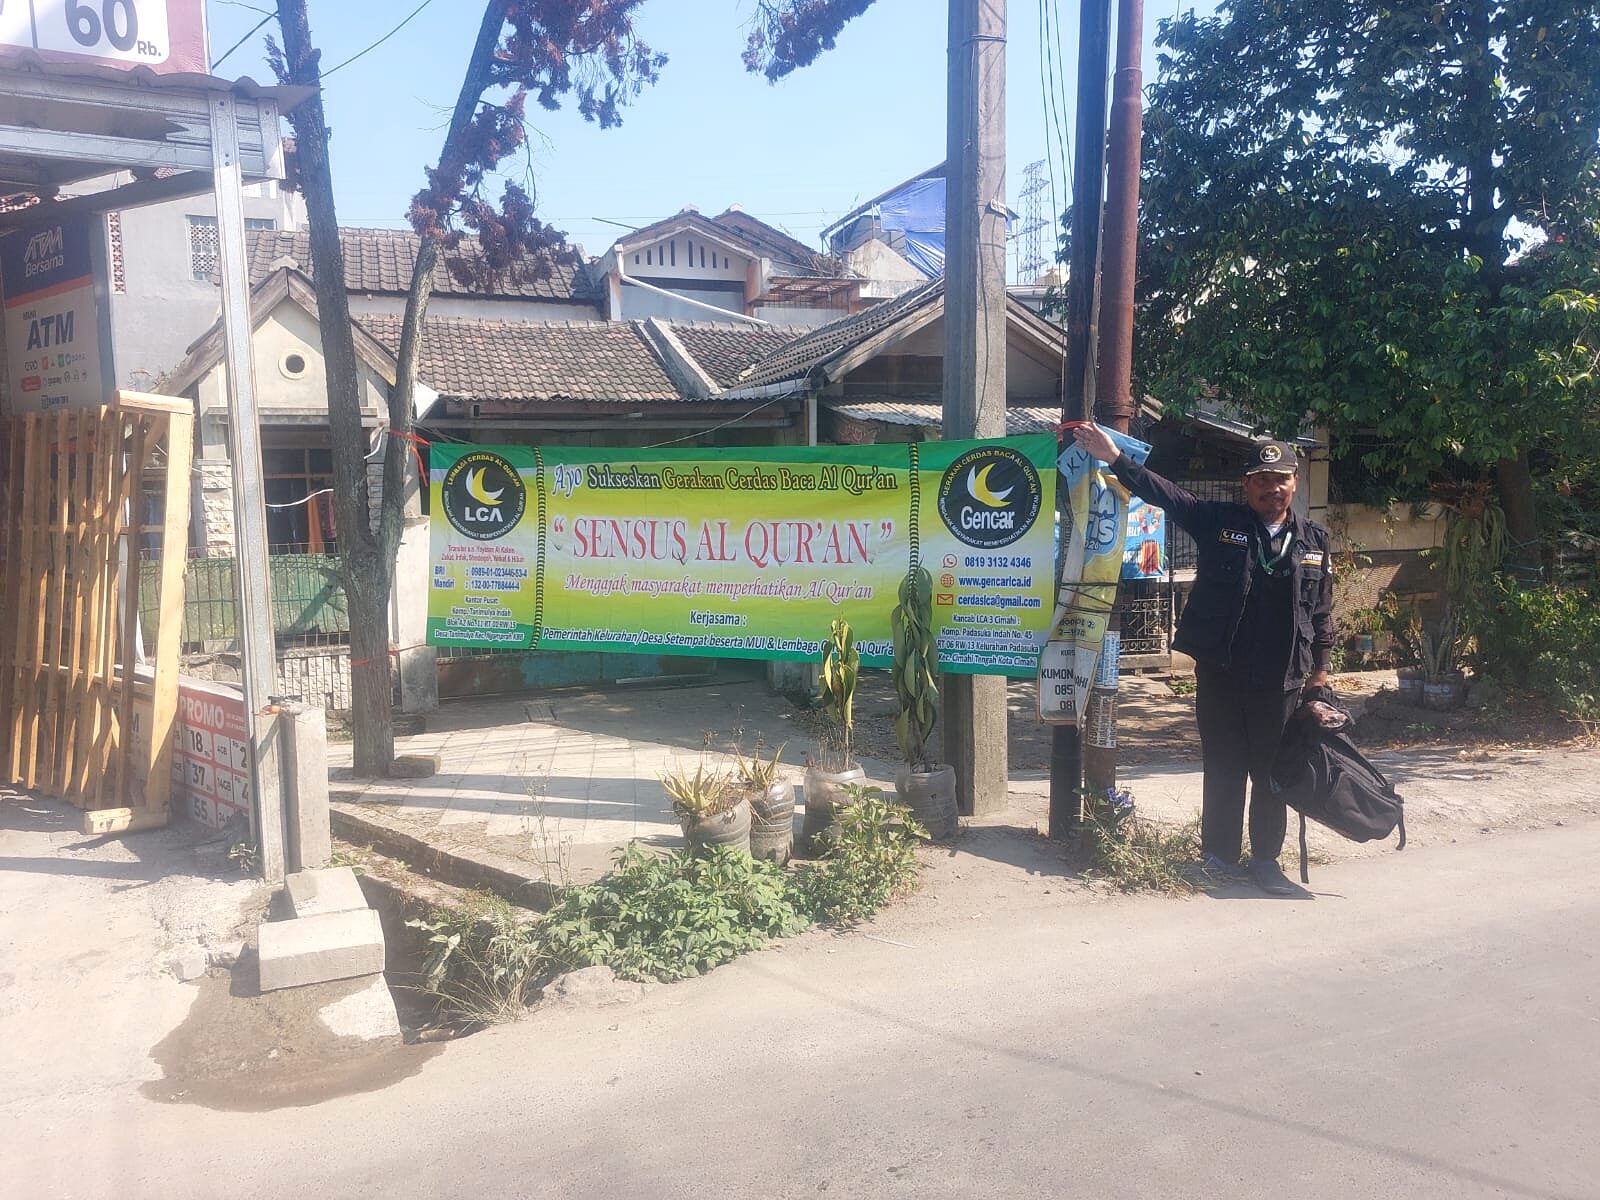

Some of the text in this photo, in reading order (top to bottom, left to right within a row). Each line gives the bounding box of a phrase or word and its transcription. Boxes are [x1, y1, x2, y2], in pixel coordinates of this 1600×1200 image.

[65, 0, 162, 57] 60 Rb.
[24, 226, 63, 262] ATM
[25, 254, 64, 278] Bersama
[27, 310, 74, 351] ATM
[552, 464, 898, 497] Ayo Sukseskan Gerakan Cerdas Baca Al Qur'an
[943, 464, 962, 496] GERAKAN
[962, 450, 992, 465] CERDAS
[994, 450, 1015, 461] BACA
[1015, 457, 1023, 467] AL
[464, 506, 504, 522] LCA
[961, 505, 1015, 530] Gencar
[574, 518, 687, 561] SENSUS
[694, 521, 736, 561] AL
[744, 521, 871, 568] QUR'AN
[1231, 532, 1248, 543] LCA
[434, 565, 445, 575] BRI
[964, 556, 1031, 568] 0819 3132 4346
[434, 579, 454, 588] Mandiri
[565, 571, 872, 604] Mengajak masyarakat memperhatikan Al Qur'an
[958, 576, 1031, 589] www.gencarlca.id
[958, 594, 1041, 609] cerdaslca@gmail.com
[690, 610, 740, 627] Kerjasama
[953, 614, 975, 623] Kancab
[976, 615, 988, 624] LCA
[988, 615, 993, 624] 3
[994, 615, 1017, 625] Cimahi
[543, 627, 593, 641] Pemerintah
[594, 630, 663, 645] Kelurahan/Desa
[664, 632, 708, 648] Setempat
[708, 635, 743, 648] beserta
[746, 636, 766, 650] MUI
[767, 637, 774, 649] &
[777, 638, 818, 655] Lembaga
[855, 640, 866, 653] Al
[867, 640, 895, 656] Qur'a
[942, 627, 1033, 639] Komp. Padasuka Indah No. 45
[937, 639, 1039, 653] RT 06 RW 13 Kelurahan Padasuka
[951, 653, 974, 663] Cimahi
[974, 655, 997, 666] Tengah
[998, 657, 1013, 665] Kota
[1014, 657, 1037, 667] Cimahi
[1041, 668, 1073, 680] KUMON
[180, 696, 224, 729] PROMO
[190, 730, 203, 753] 18
[240, 746, 248, 768] 2
[192, 763, 205, 786] 37
[193, 796, 208, 820] 55
